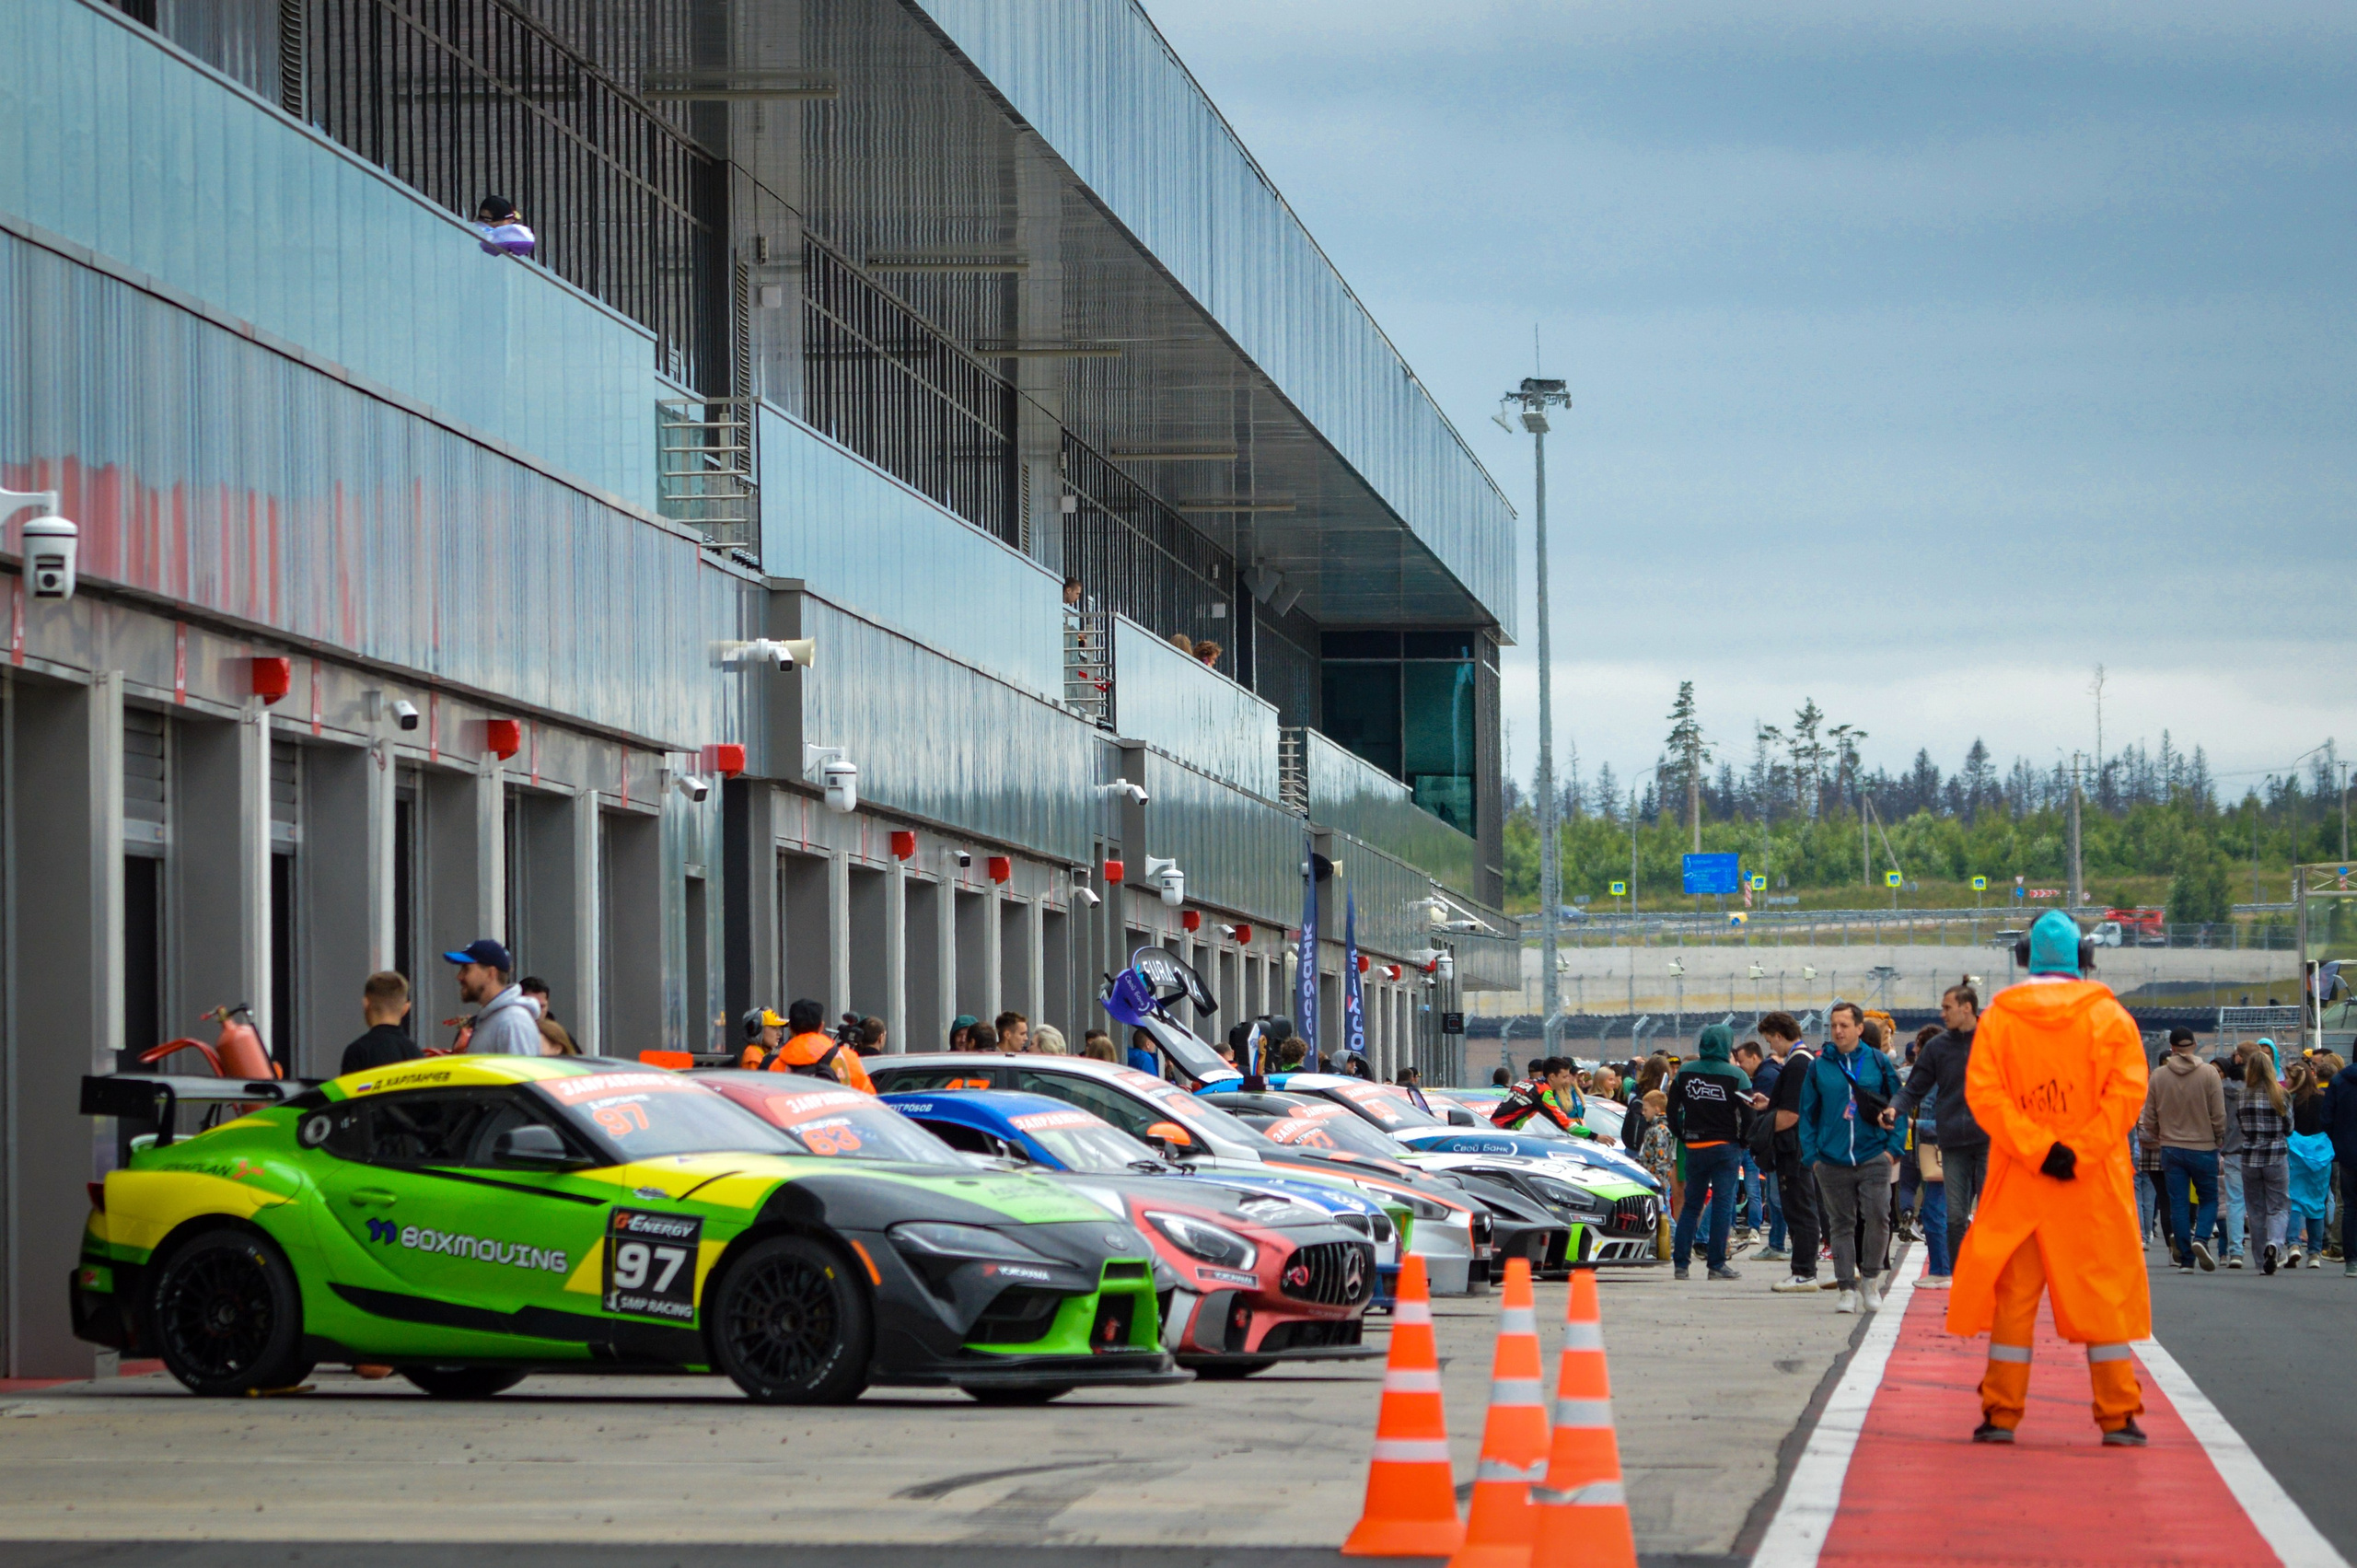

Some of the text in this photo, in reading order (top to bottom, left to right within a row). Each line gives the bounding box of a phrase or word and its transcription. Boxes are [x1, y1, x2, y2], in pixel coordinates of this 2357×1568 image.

[1691, 1086, 1720, 1097] VRC
[593, 1102, 649, 1134] 97
[803, 1124, 862, 1155] 63
[1453, 1144, 1509, 1153] Свой Банк
[401, 1225, 569, 1274] BOXMOVING
[614, 1242, 688, 1293] 97
[1214, 1272, 1254, 1285] YOKOHAMA
[620, 1295, 694, 1318] SMP RACING
